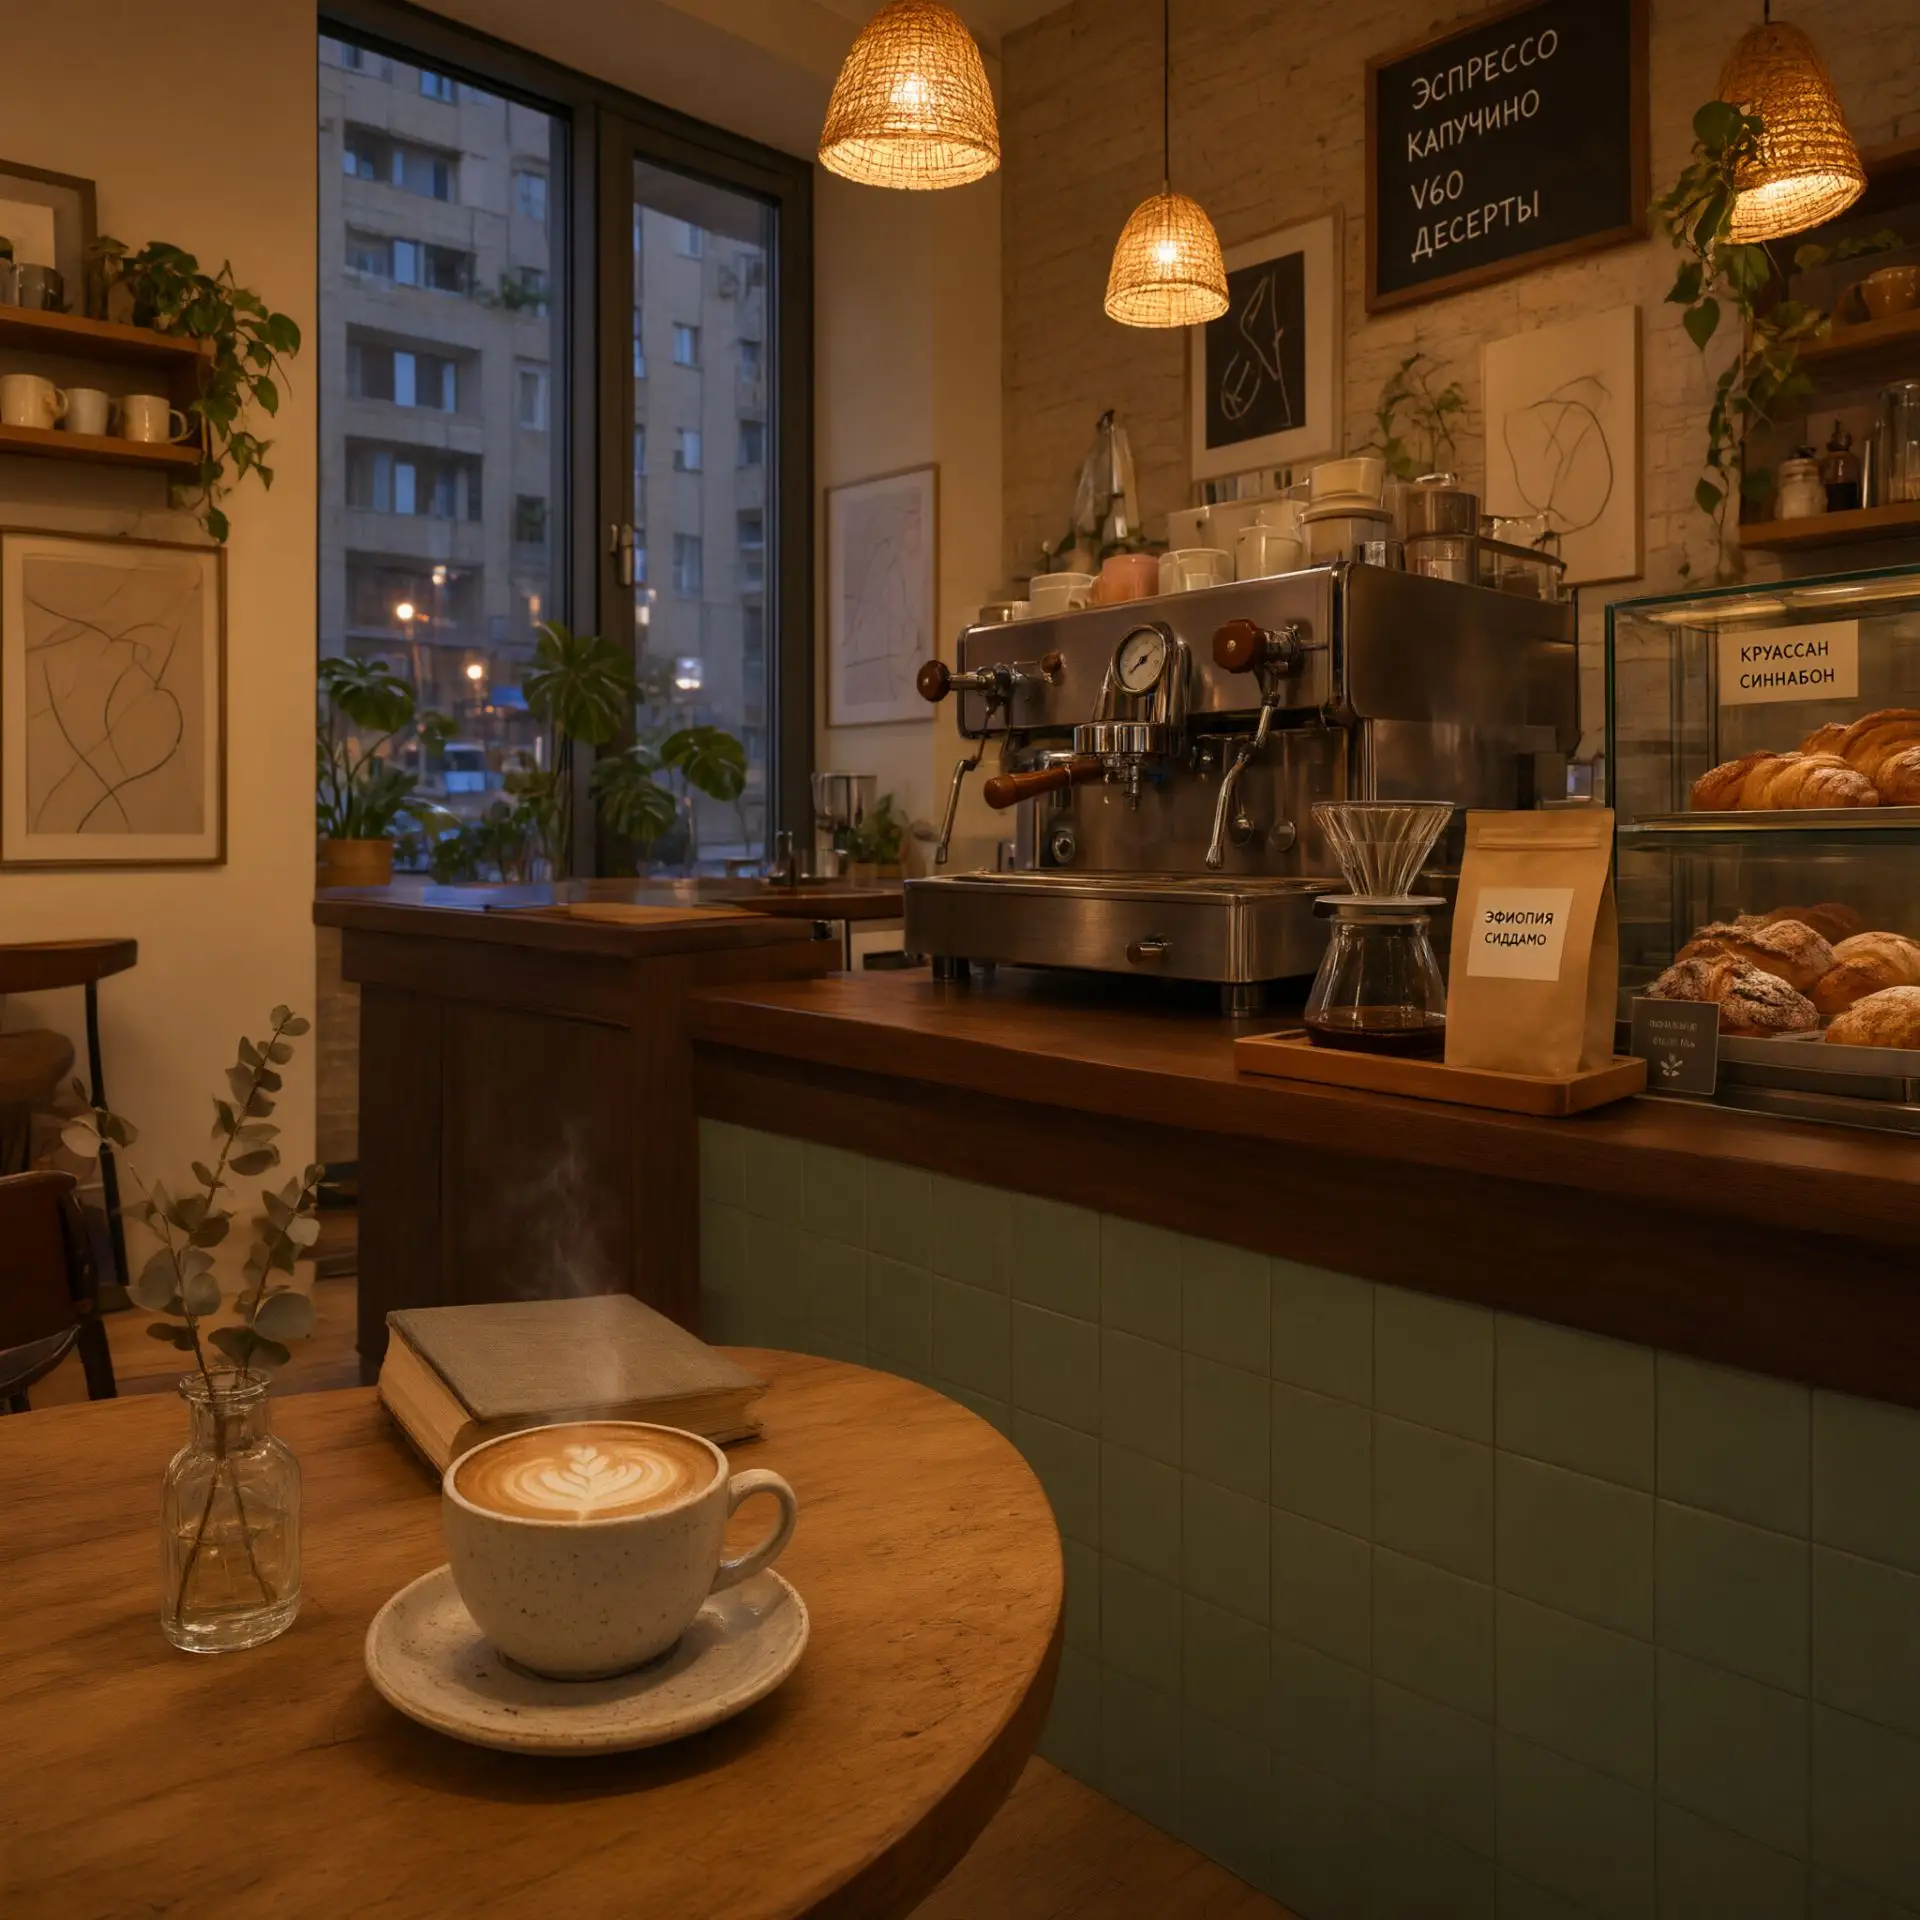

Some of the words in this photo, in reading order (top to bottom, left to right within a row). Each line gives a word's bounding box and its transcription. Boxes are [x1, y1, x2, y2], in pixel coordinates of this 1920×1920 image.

[1411, 29, 1558, 110] ЭСПРЕССО
[1408, 89, 1540, 163] КАПУЧИНО
[1410, 170, 1464, 210] V60
[1411, 190, 1539, 263] ДЕСЕРТЫ
[1741, 640, 1829, 663] КРУАССАН
[1740, 668, 1835, 689] СИННАБОН
[1484, 910, 1554, 925] ЭФИОПИЯ
[1484, 932, 1547, 947] СИДДАМО
